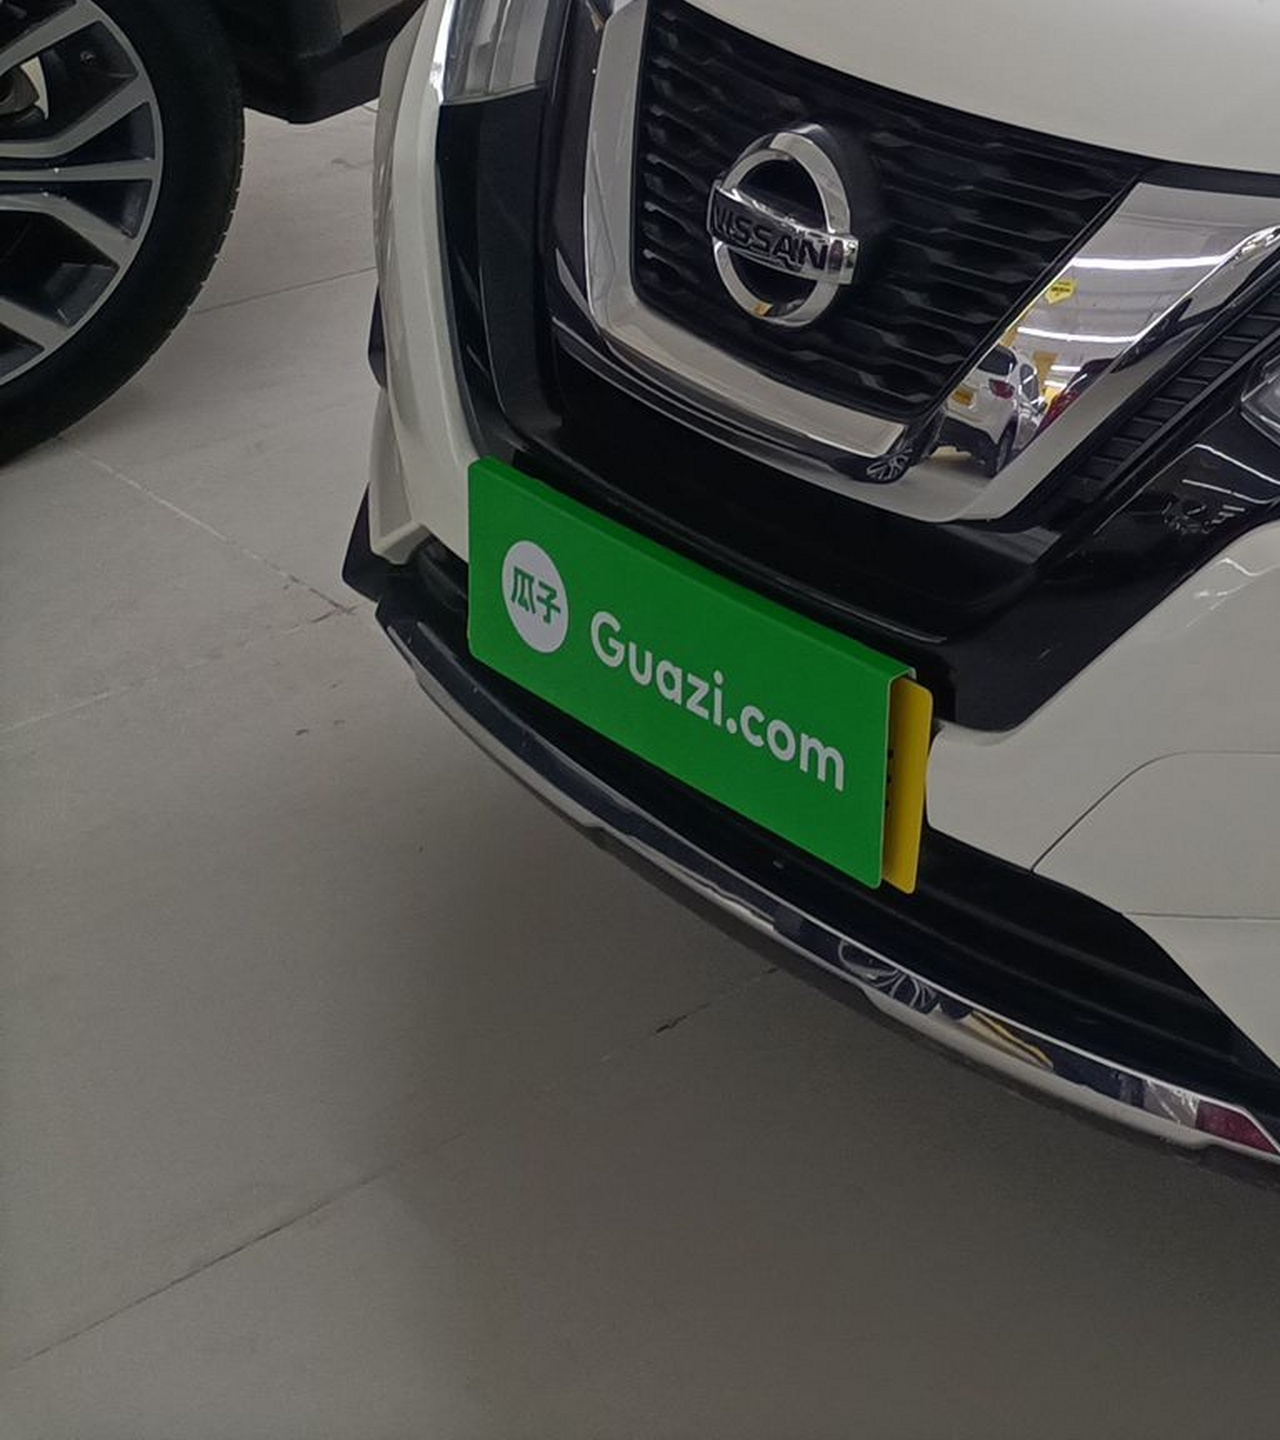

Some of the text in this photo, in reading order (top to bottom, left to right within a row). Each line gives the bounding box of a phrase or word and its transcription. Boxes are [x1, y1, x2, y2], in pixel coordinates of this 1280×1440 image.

[712, 200, 829, 272] NISSAN
[510, 565, 562, 625] 瓜子
[590, 610, 845, 793] Guazi.com
